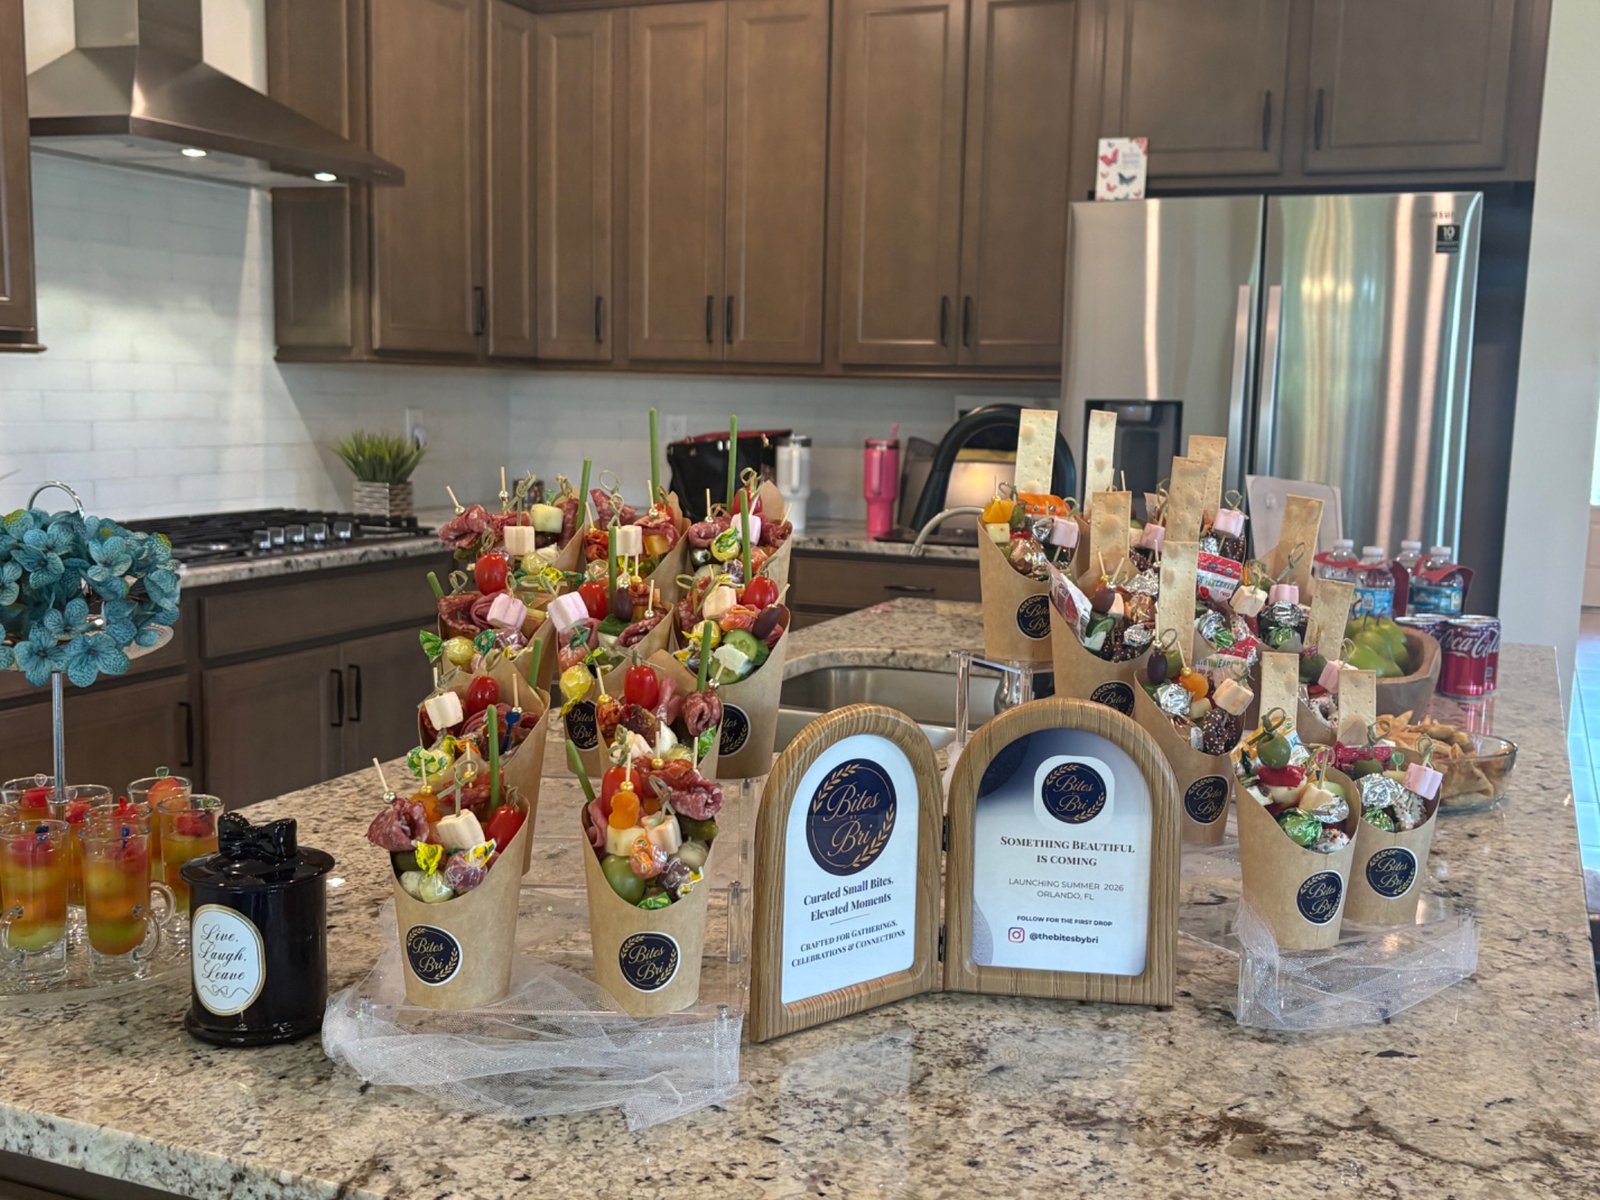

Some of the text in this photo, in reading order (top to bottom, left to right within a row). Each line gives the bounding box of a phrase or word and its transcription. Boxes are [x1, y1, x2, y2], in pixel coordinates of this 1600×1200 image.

[1052, 774, 1094, 793] Bites
[823, 781, 880, 822] Bites
[1055, 794, 1089, 812] Bri
[827, 818, 873, 857] Bri
[1000, 836, 1136, 854] SOMETHING BEAUTIFUL
[1036, 855, 1097, 867] IS COMING
[1375, 857, 1408, 872] Bites
[803, 876, 894, 906] Curated Small Bites.
[1008, 878, 1125, 892] LAUNCHING SUMMER 2026
[1036, 890, 1095, 901] ORLANDO, FL
[810, 893, 892, 922] Elevated Moments
[412, 936, 444, 953] Bites
[800, 936, 835, 952] CRAFTED
[835, 932, 851, 943] FOR
[1029, 932, 1099, 944] @thebitesbybri
[628, 944, 664, 964] Bites
[791, 929, 906, 968] CELEBRATIONS & CONNECTIONS
[202, 961, 245, 982] Leave
[418, 956, 444, 972] Bri
[635, 961, 665, 981] Bri
